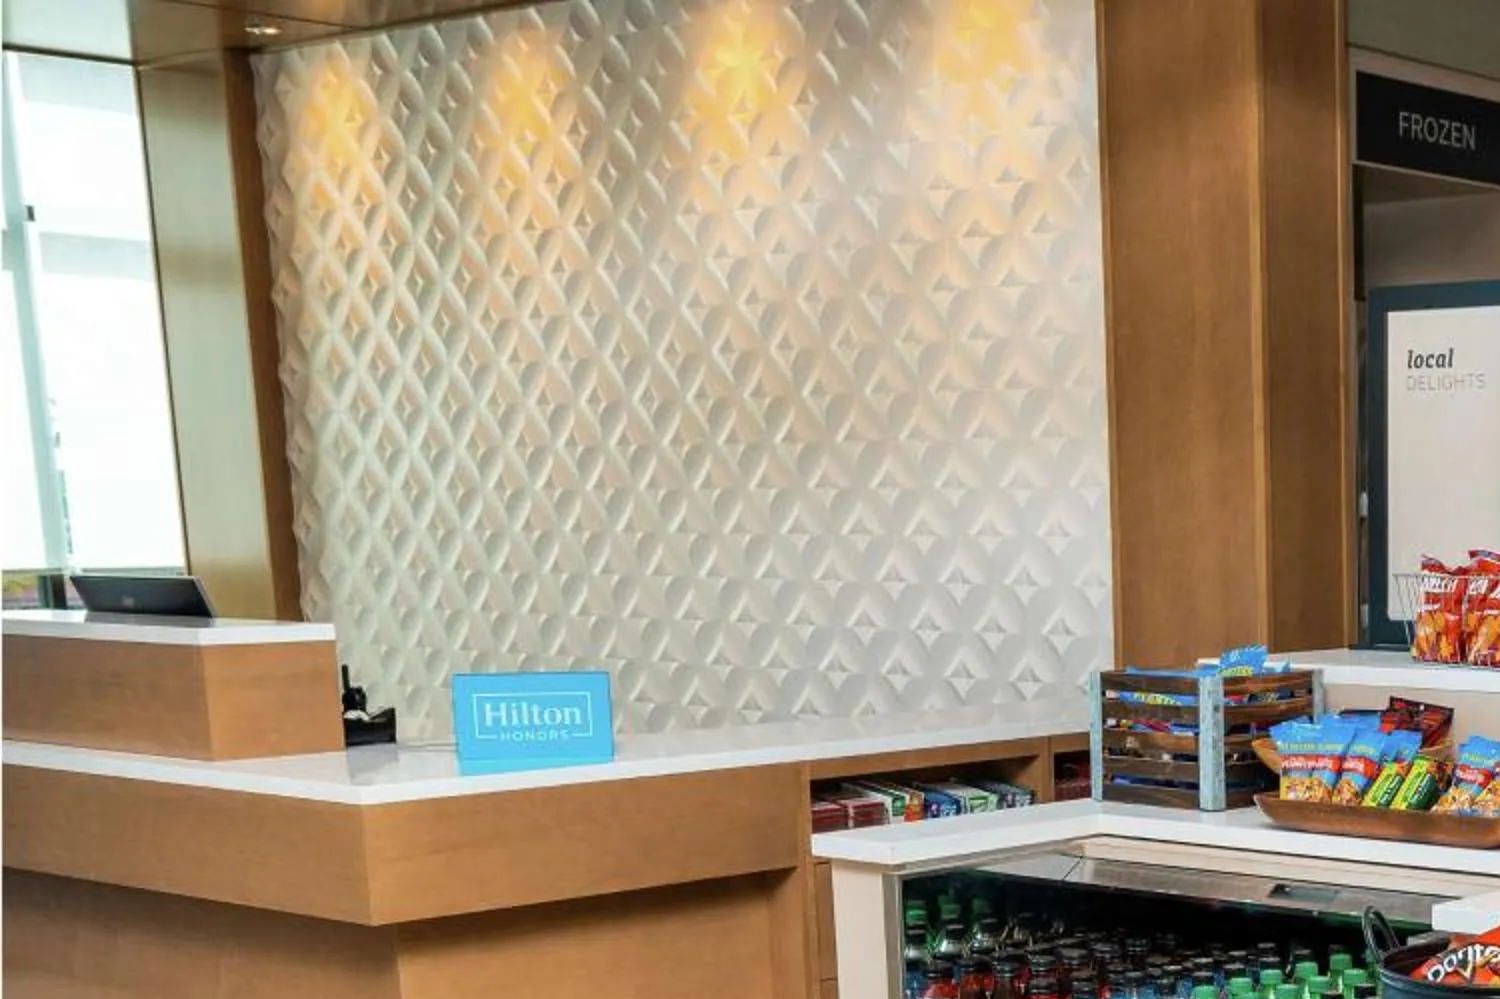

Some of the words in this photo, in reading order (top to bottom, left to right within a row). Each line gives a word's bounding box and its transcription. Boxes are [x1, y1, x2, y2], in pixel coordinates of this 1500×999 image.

[1398, 111, 1476, 150] FROZEN
[1407, 347, 1454, 370] local
[1405, 373, 1487, 391] DELIGHTS
[484, 701, 582, 727] Hilton
[500, 729, 569, 742] HONORS
